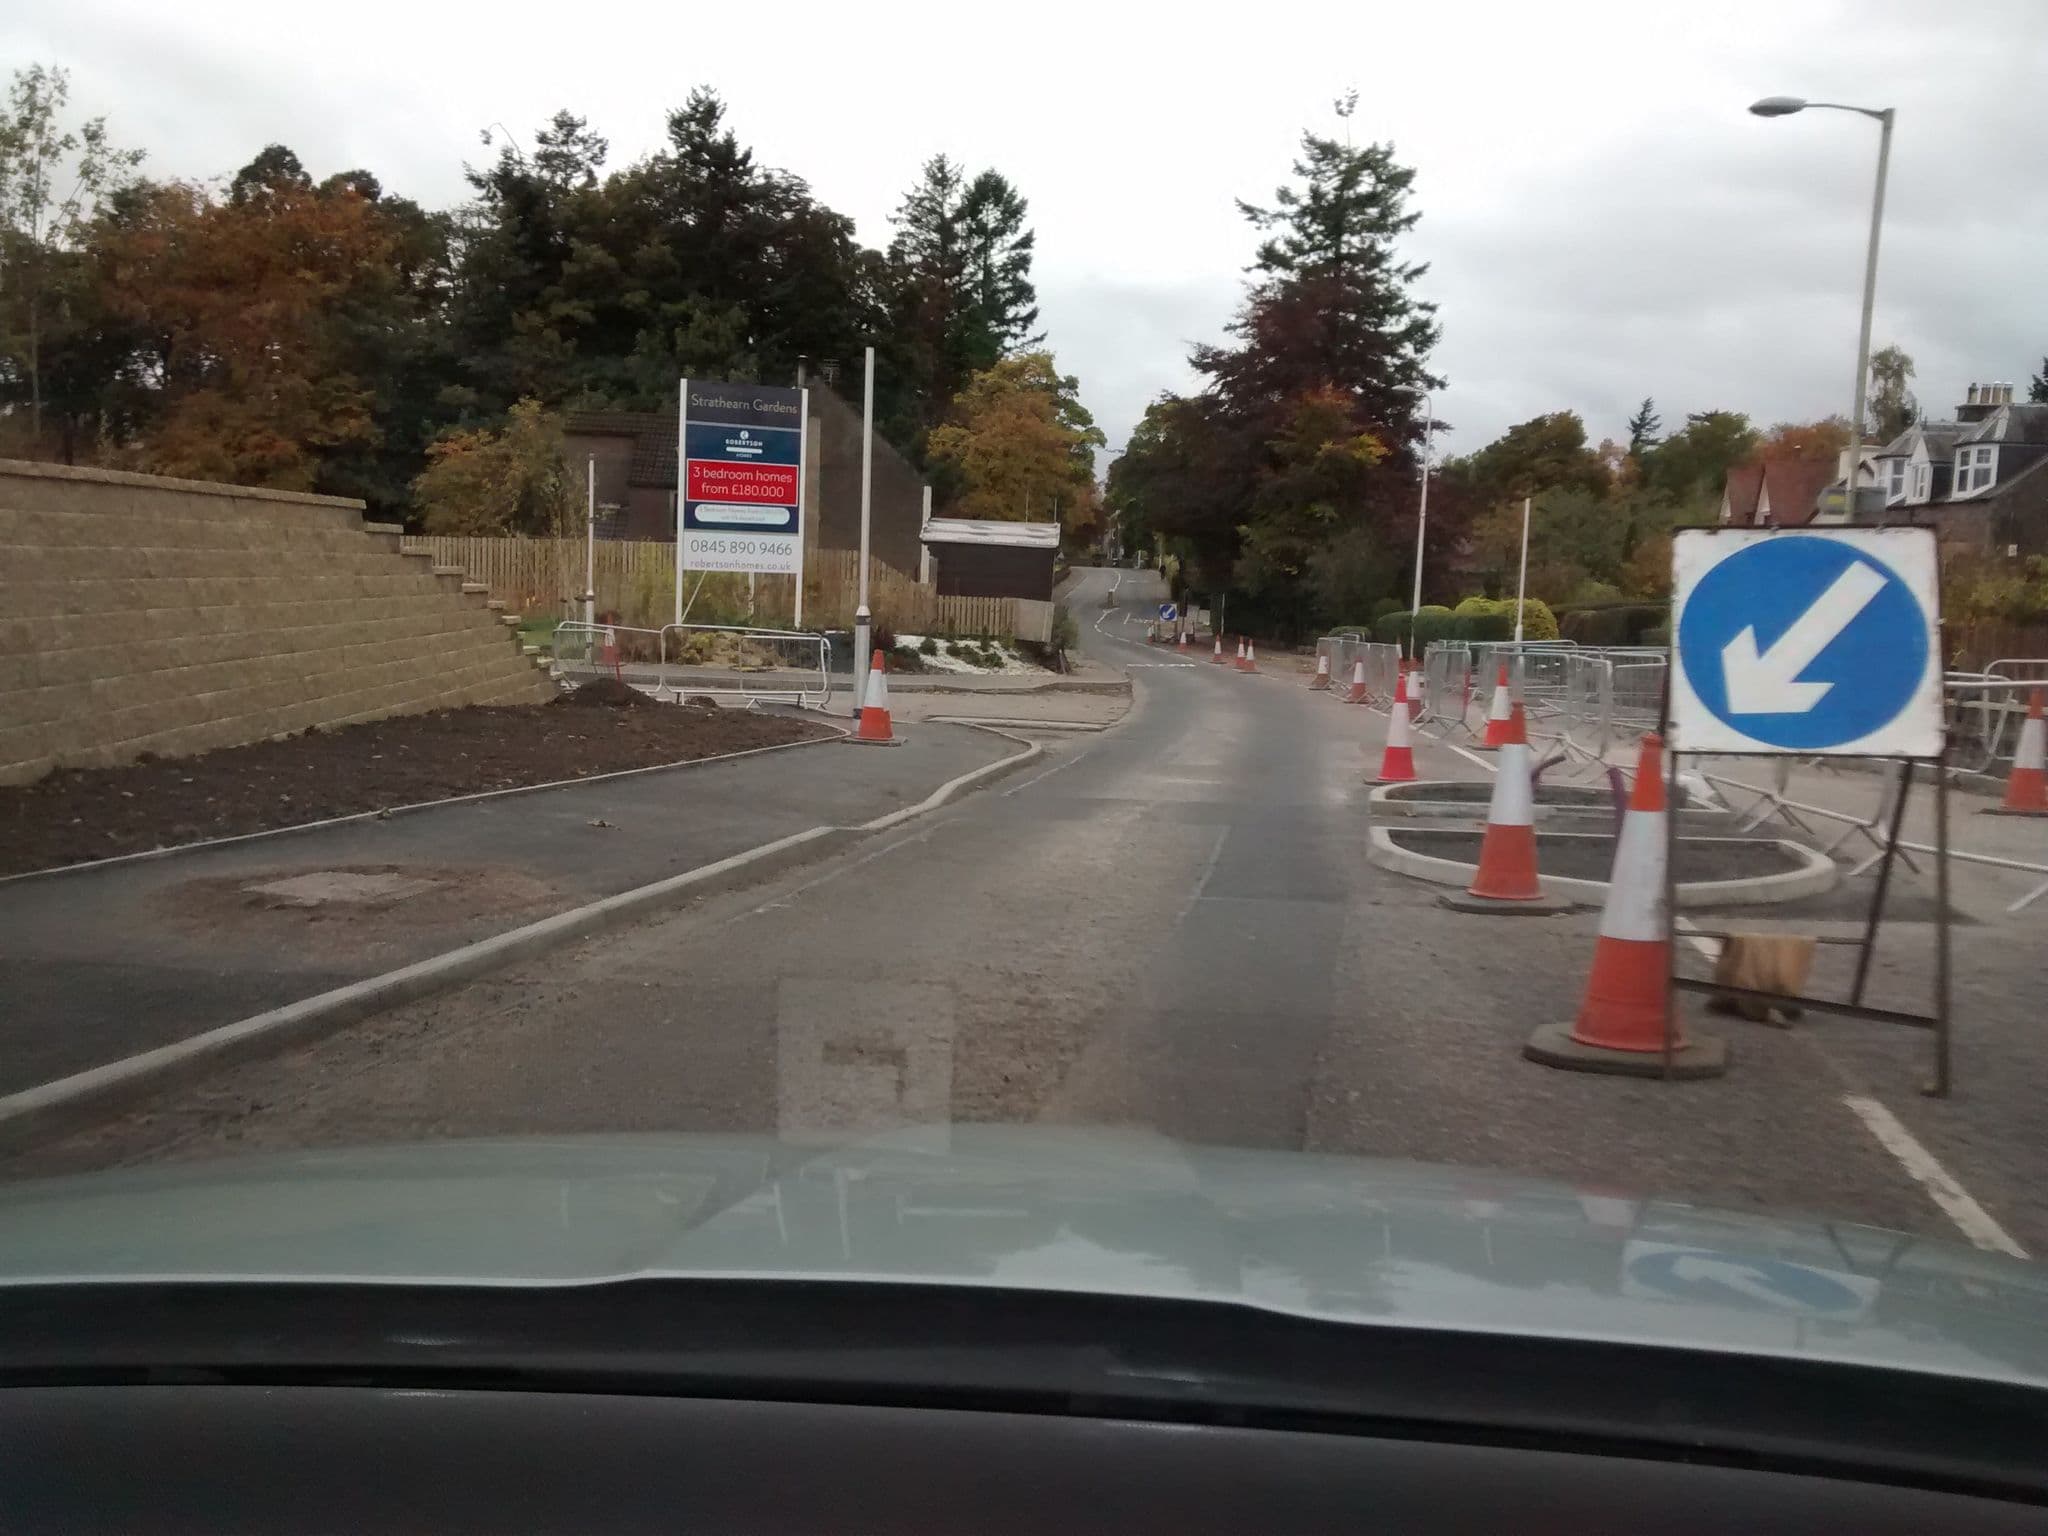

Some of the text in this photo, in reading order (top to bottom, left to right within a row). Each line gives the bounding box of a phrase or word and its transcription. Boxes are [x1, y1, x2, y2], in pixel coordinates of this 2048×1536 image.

[691, 393, 798, 414] Strathearn Gardens
[693, 466, 793, 483] 3 bedroom homes
[701, 482, 729, 495] from
[690, 539, 793, 556] 0845 890 9466
[690, 559, 792, 571] robertsonhomes.co.uk
